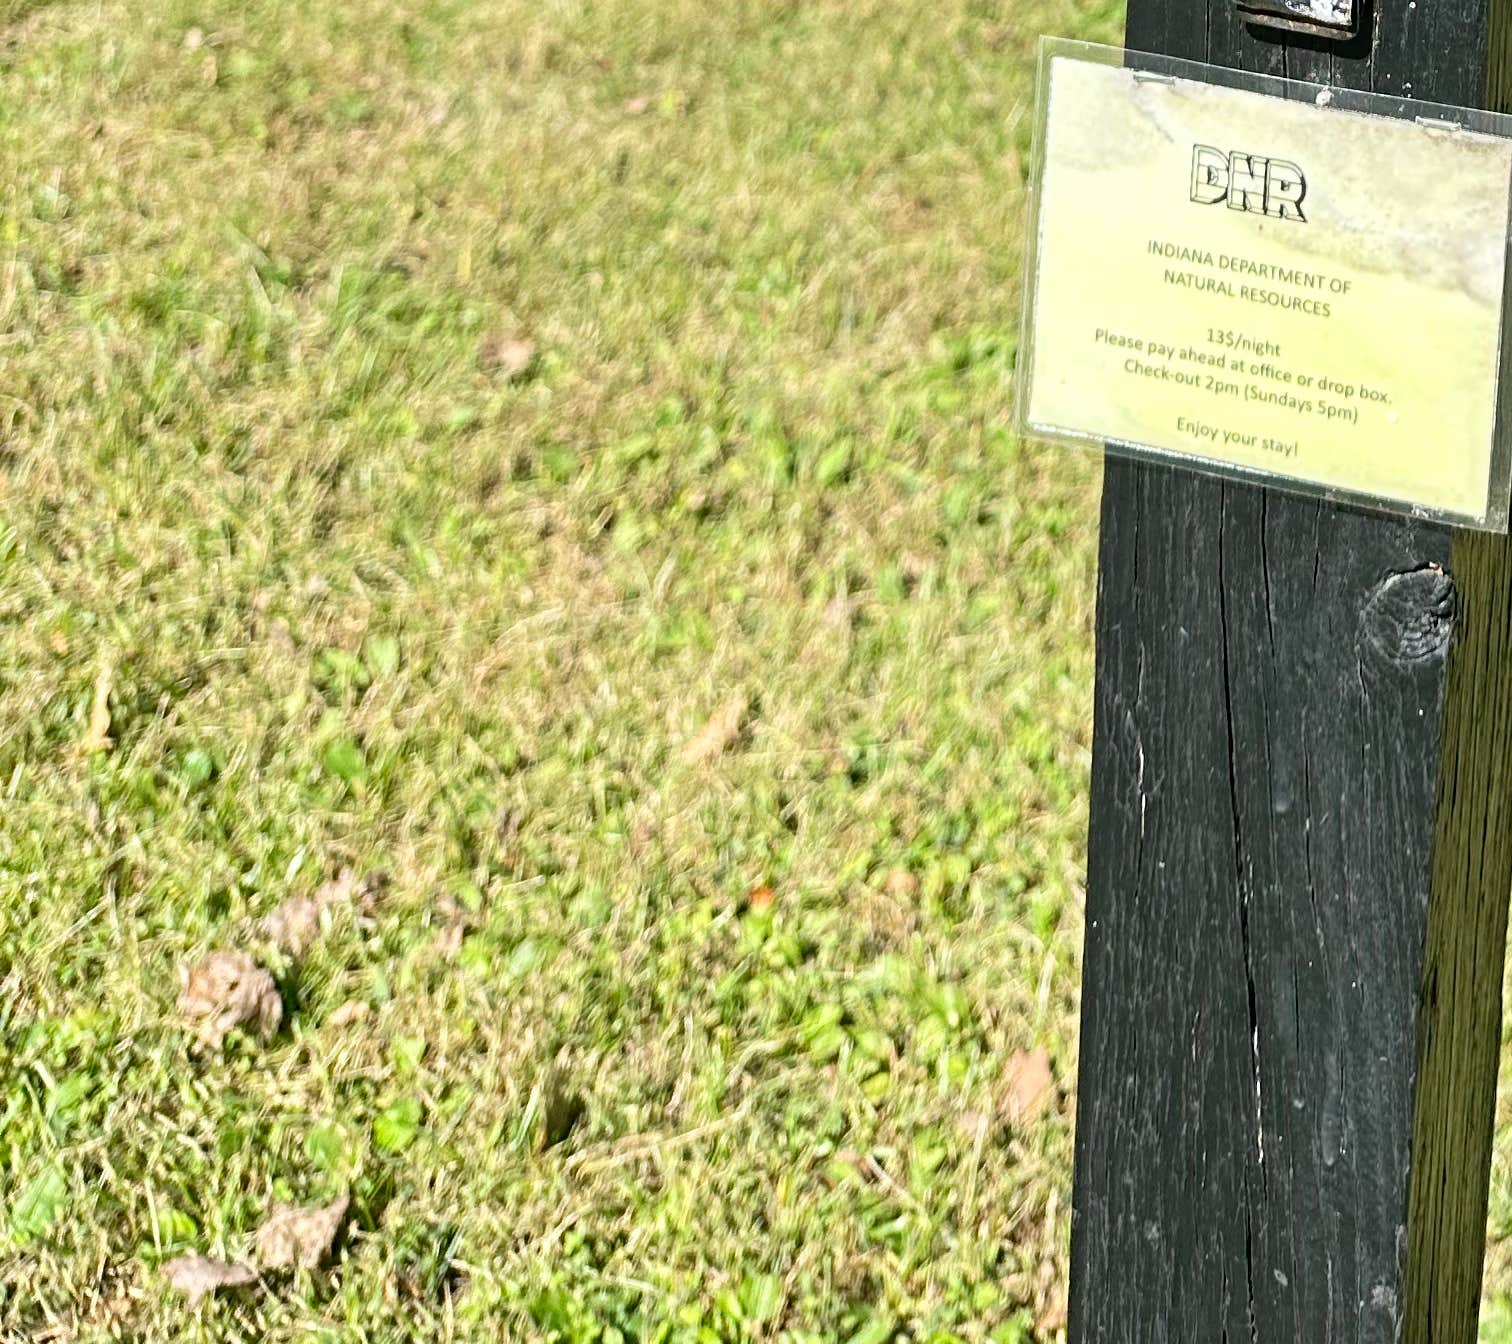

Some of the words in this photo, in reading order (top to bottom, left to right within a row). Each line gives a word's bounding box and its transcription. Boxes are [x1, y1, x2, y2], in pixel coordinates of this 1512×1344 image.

[1190, 143, 1308, 223] DNR
[1147, 239, 1213, 267] INDIANA
[1219, 254, 1326, 290] DEPARTMENT
[1330, 278, 1352, 295] OF
[1164, 268, 1235, 297] NATURAL
[1240, 286, 1331, 317] RESOURCES
[1095, 327, 1143, 351] Please
[1148, 341, 1174, 361] pay
[1179, 346, 1226, 369] ahead
[1230, 360, 1245, 373] at
[1250, 363, 1292, 384] office
[1297, 374, 1313, 387] or
[1318, 375, 1354, 398] drop
[1359, 380, 1392, 404] box.
[1207, 328, 1281, 357] 13$/night
[1124, 358, 1201, 388] Check-out
[1205, 376, 1239, 397] 2pm
[1244, 383, 1312, 413] (Sundays
[1317, 400, 1359, 424] 5pm)
[1177, 416, 1219, 441] Enjoy
[1223, 430, 1257, 448] your
[1262, 438, 1298, 457] stay!
